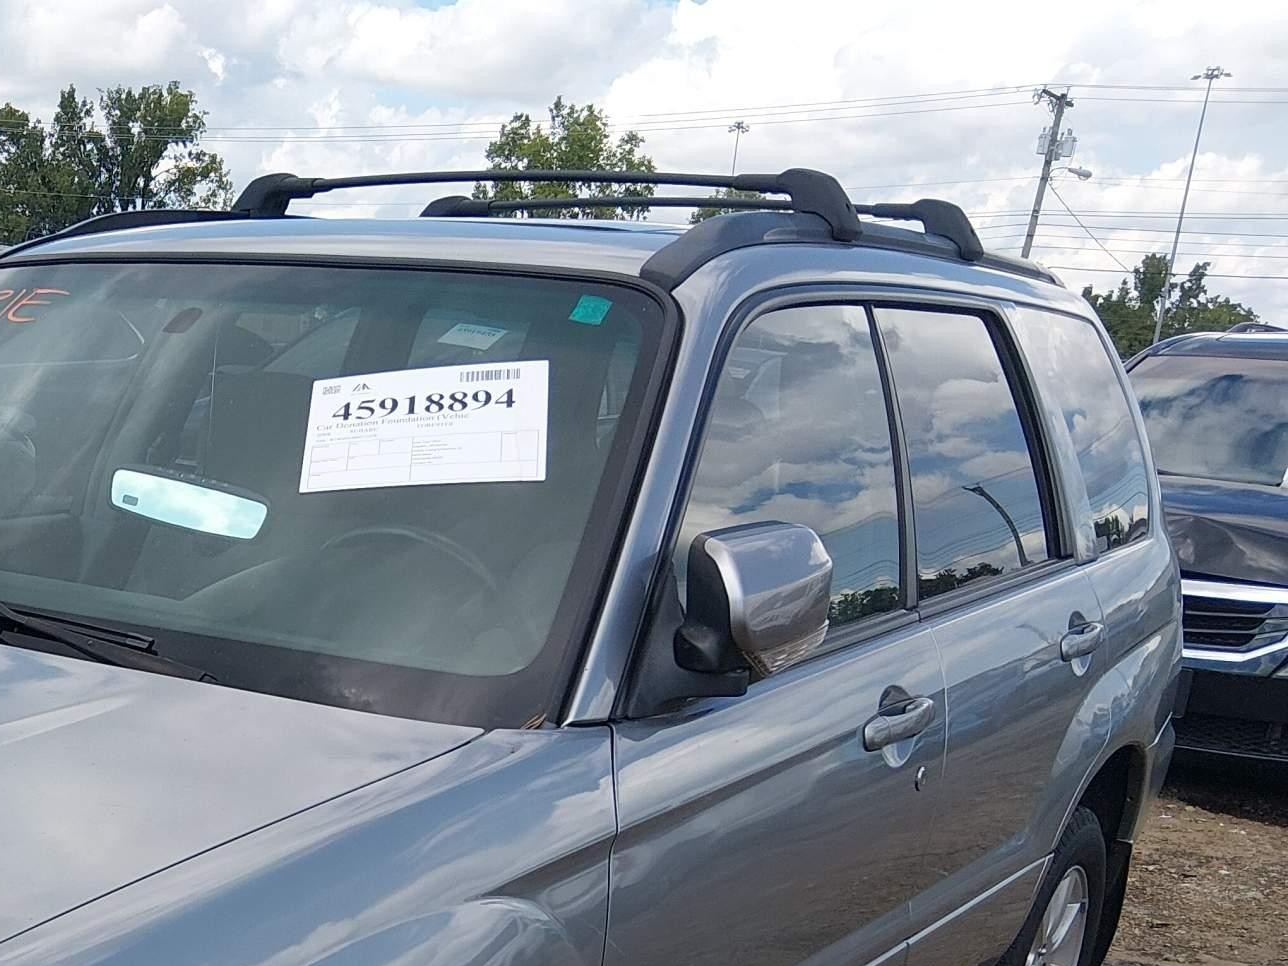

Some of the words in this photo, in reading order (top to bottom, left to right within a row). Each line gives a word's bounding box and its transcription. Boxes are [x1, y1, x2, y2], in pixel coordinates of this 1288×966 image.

[332, 388, 516, 421] 45918894
[335, 420, 379, 430] Donation
[381, 415, 434, 425] Foundation
